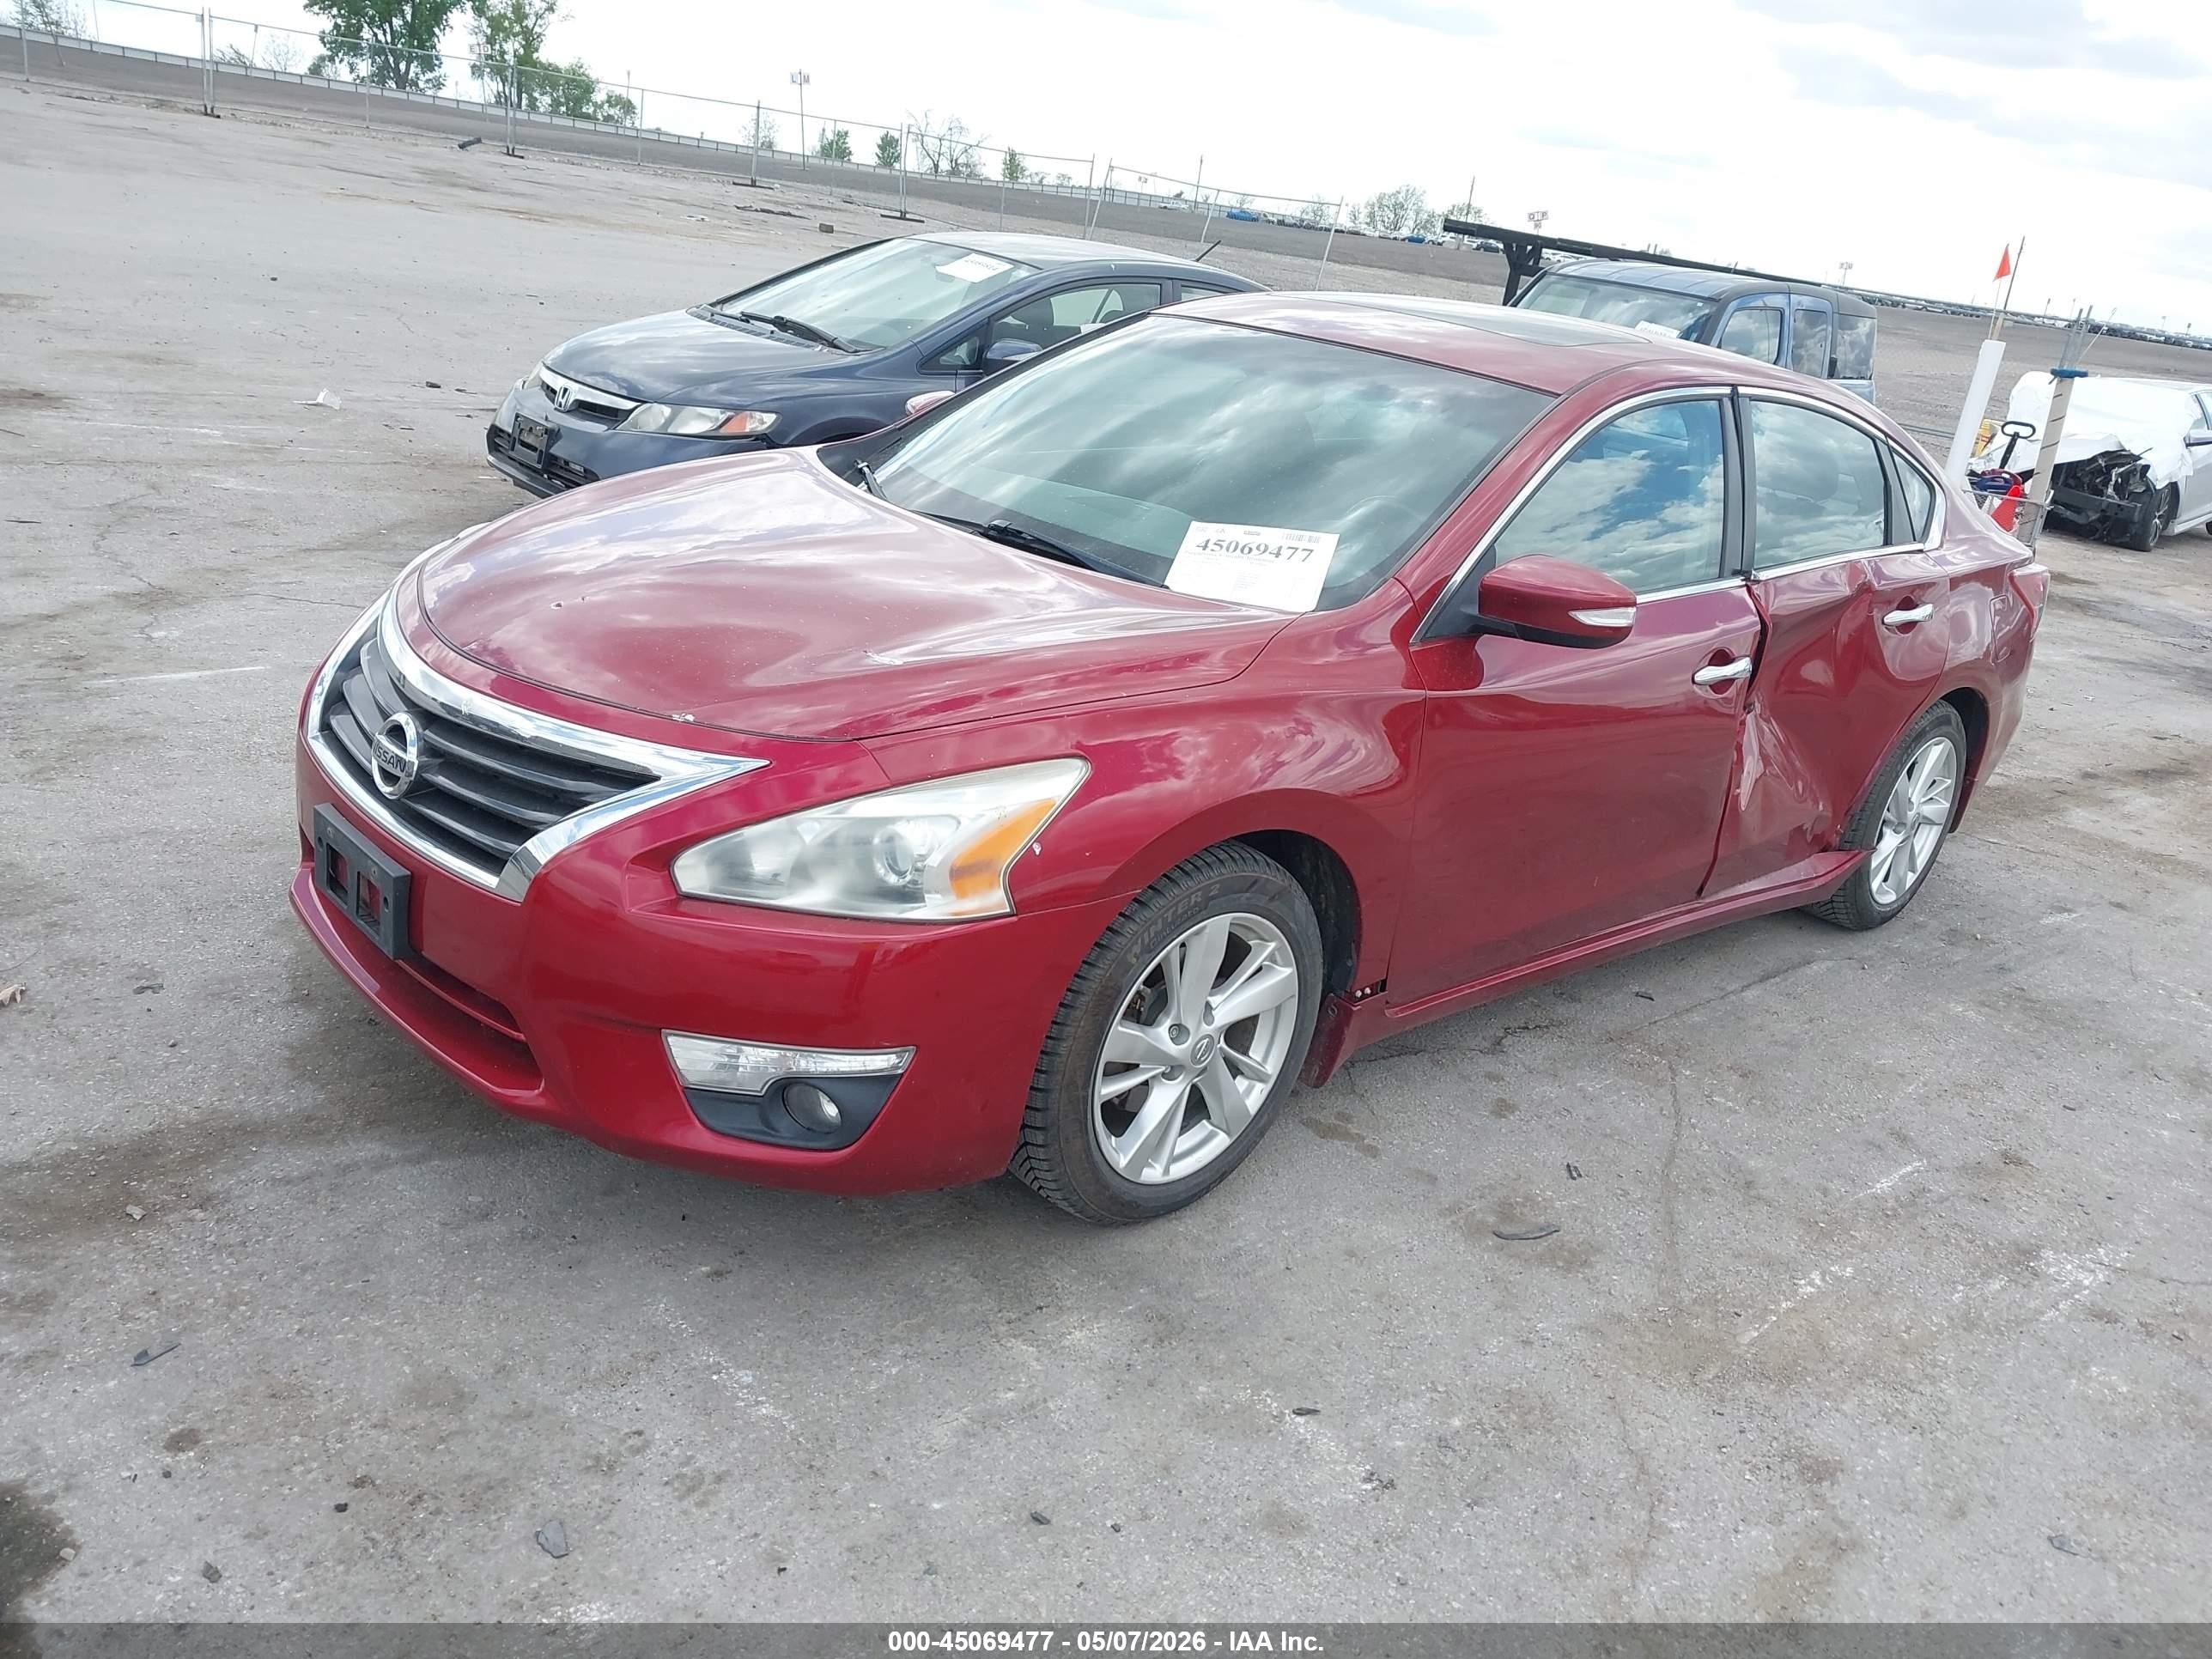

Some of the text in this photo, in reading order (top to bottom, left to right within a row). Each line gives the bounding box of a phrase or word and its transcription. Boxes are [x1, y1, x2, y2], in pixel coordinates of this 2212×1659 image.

[1195, 538, 1315, 563] 45069477
[1126, 884, 1221, 963] WINTER 2
